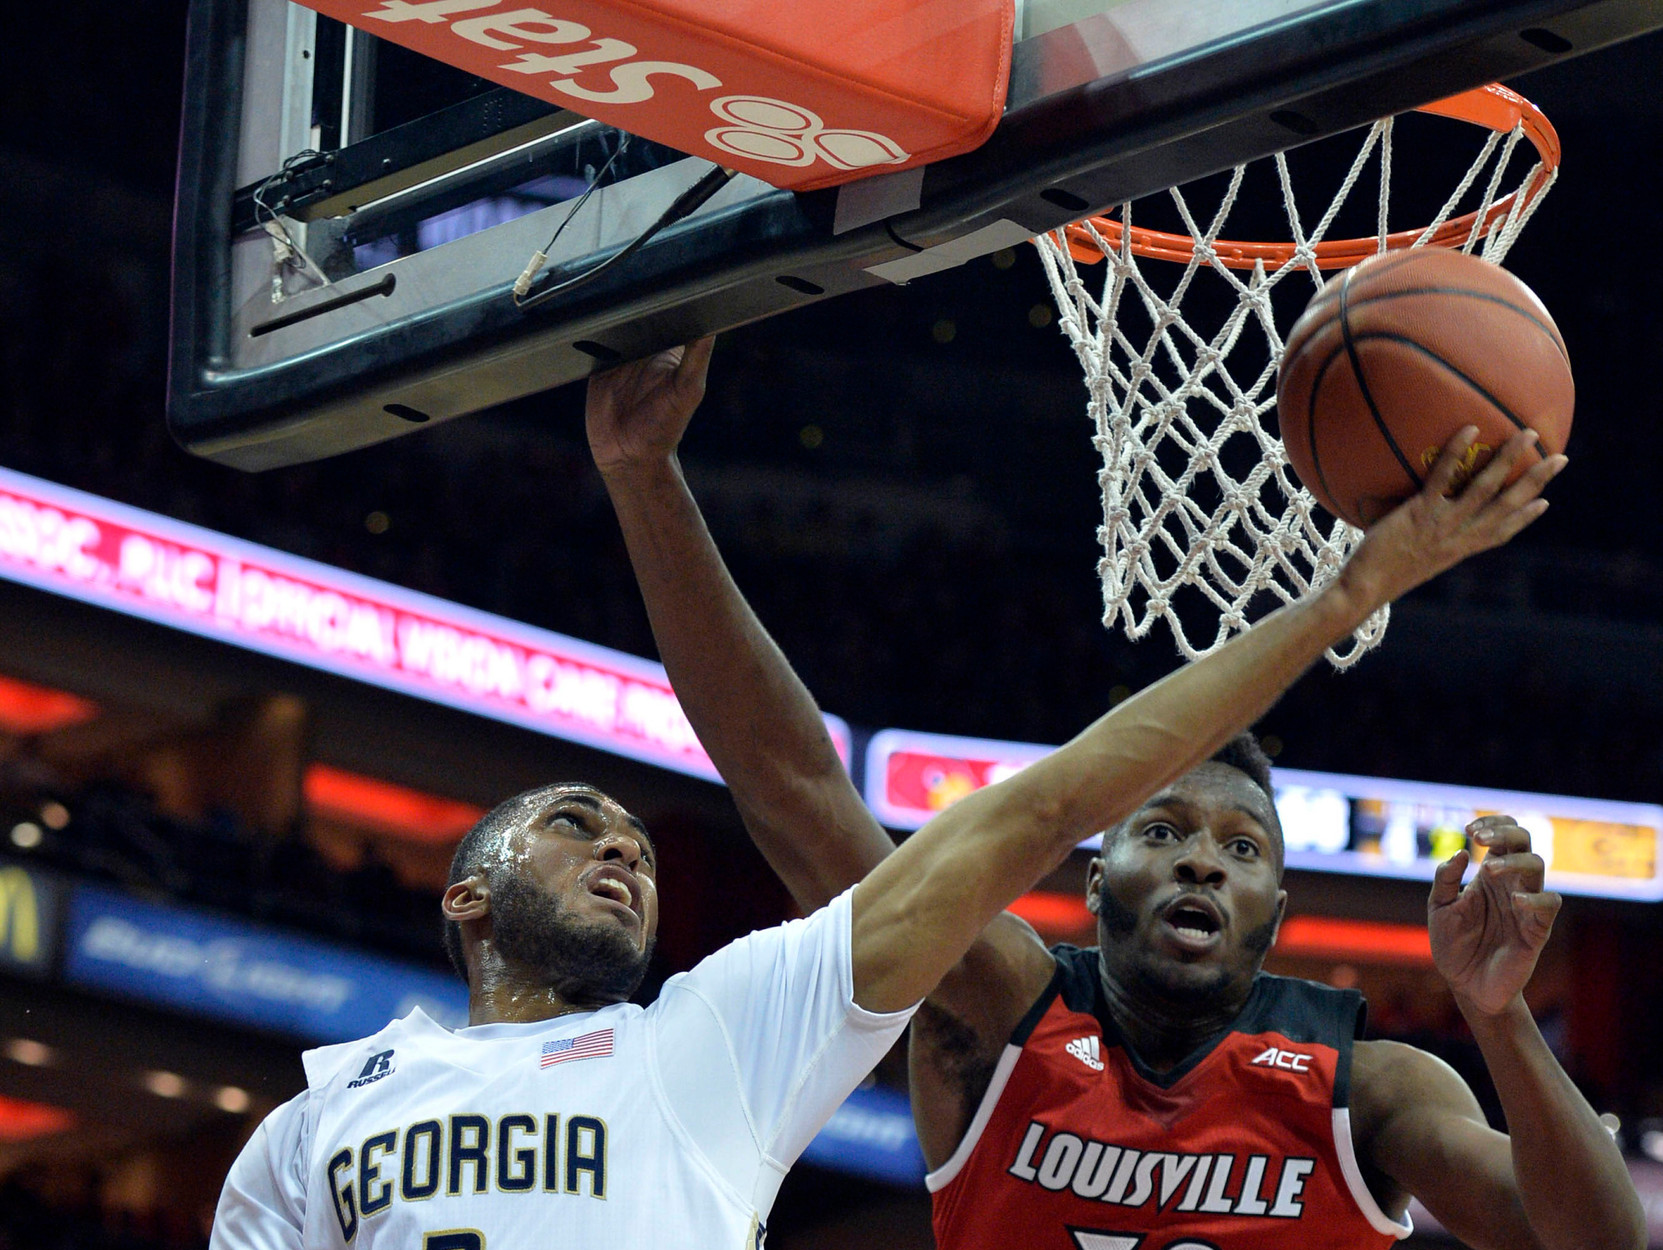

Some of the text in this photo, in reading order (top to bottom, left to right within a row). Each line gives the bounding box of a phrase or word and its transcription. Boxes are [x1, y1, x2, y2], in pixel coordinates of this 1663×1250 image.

[1065, 1042, 1105, 1071] adidas
[1251, 1046, 1314, 1072] ACC
[327, 1112, 608, 1244] GEORGIA
[1007, 1119, 1317, 1218] LOUISVILLE
